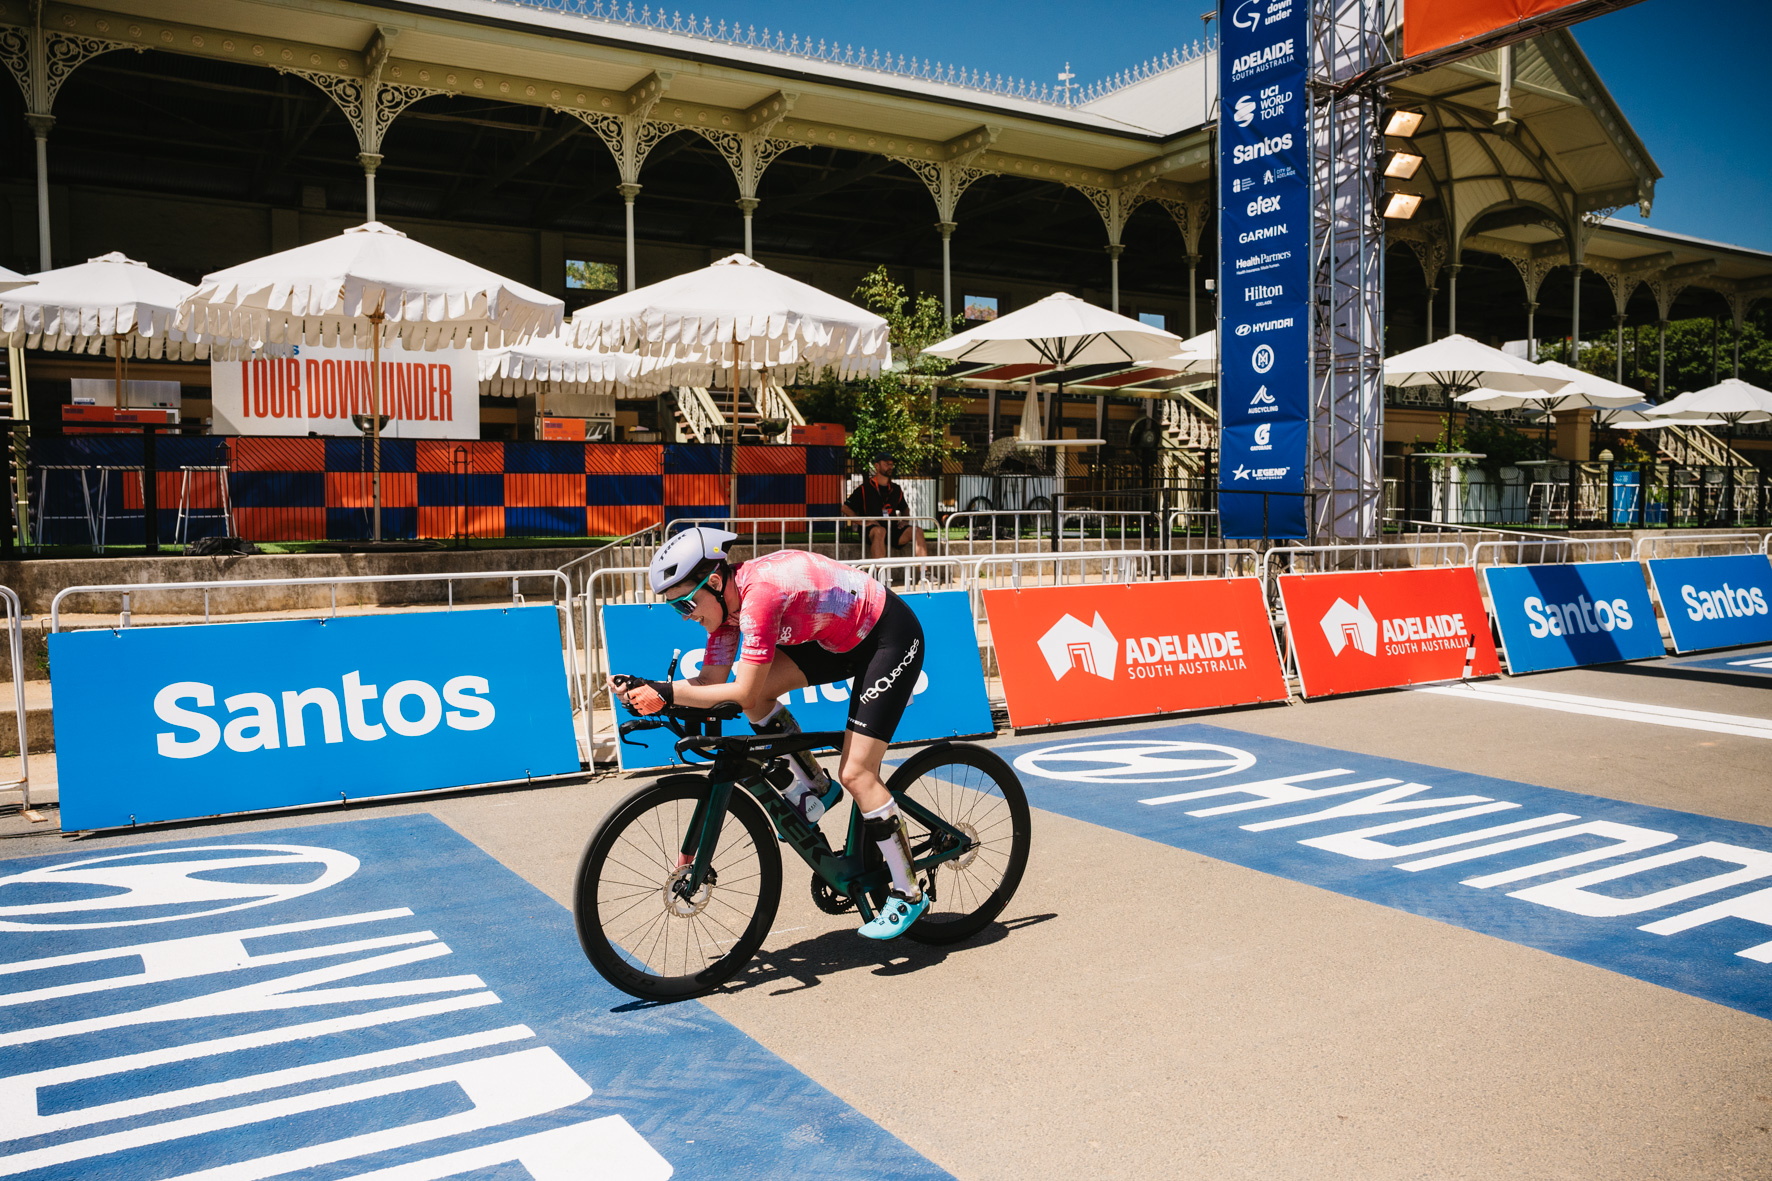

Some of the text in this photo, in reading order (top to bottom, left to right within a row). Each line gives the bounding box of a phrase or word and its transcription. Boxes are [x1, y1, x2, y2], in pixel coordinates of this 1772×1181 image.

[1265, 9, 1292, 25] under
[1267, 0, 1292, 14] down
[1232, 38, 1294, 74] ADELAIDE
[1232, 54, 1294, 82] SOUTH AUSTRALIA
[1260, 85, 1279, 99] UCI
[1260, 91, 1293, 110] WORLD
[1260, 105, 1284, 120] TOUR
[1233, 133, 1293, 165] Santos
[1247, 195, 1281, 217] efex
[1239, 223, 1288, 244] GARMIN
[1244, 284, 1283, 302] Hilton
[1252, 317, 1294, 333] HYUNDAI
[241, 357, 453, 421] TOUR DOWN UNDER
[1248, 405, 1279, 414] AUSCYCLING
[658, 533, 687, 561] TREK
[1681, 582, 1769, 622] Santos
[1382, 613, 1468, 643] ADELAIDE
[1523, 594, 1634, 639] Santos
[1126, 631, 1244, 665] ADELAIDE
[1385, 637, 1471, 656] SOUTH AUSTRALIA
[859, 638, 920, 705] frequencies
[1127, 658, 1247, 680] SOUTH AUSTRALIA
[153, 670, 496, 759] Santos
[744, 776, 834, 867] TREK
